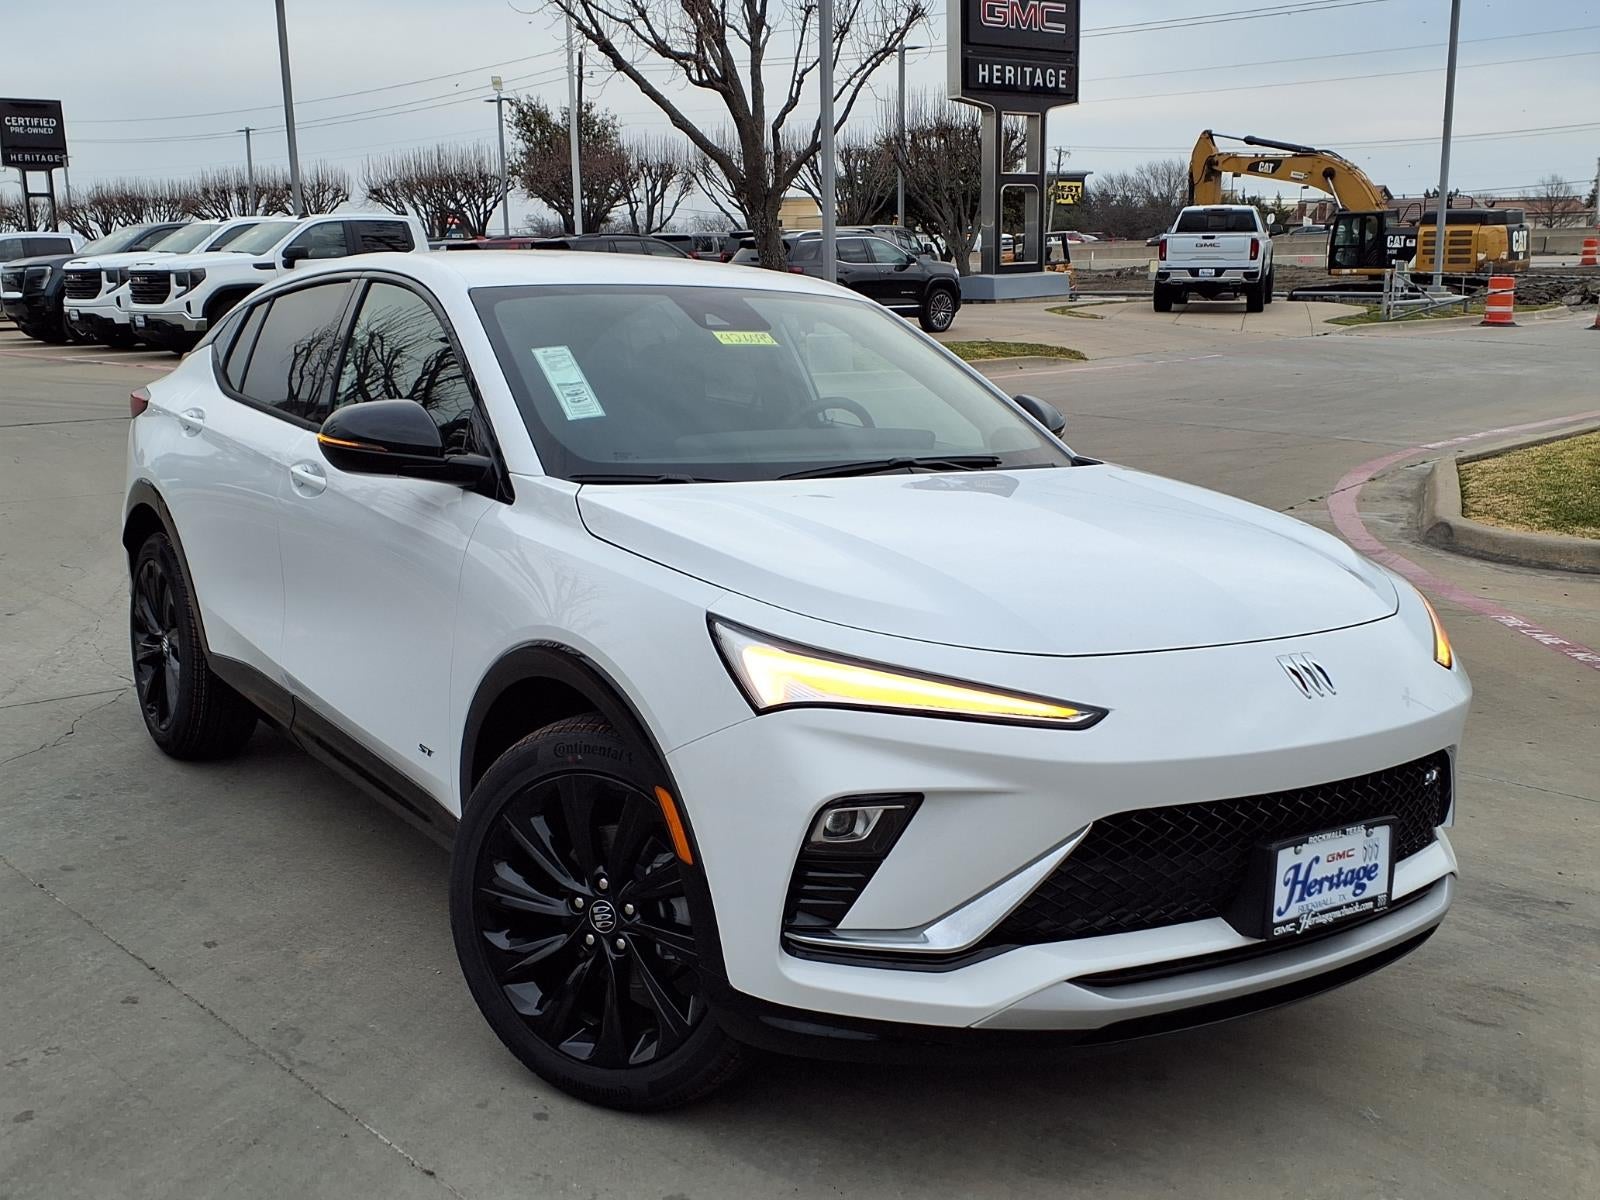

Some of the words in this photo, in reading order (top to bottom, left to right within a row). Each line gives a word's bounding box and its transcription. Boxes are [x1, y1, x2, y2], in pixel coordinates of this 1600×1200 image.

[981, 0, 1066, 34] GMC
[978, 63, 1066, 88] HERITAGE
[5, 117, 57, 127] CERTIFIED
[10, 126, 54, 134] PRE-OWNED
[10, 154, 60, 162] HERITAGE
[1258, 161, 1274, 174] CAT
[1386, 235, 1406, 248] CAT
[1512, 230, 1528, 252] CAT
[418, 743, 435, 757] ST
[553, 741, 625, 761] Continental
[1326, 848, 1356, 863] GMC
[1276, 855, 1380, 917] Heritage
[1273, 922, 1297, 936] GMC
